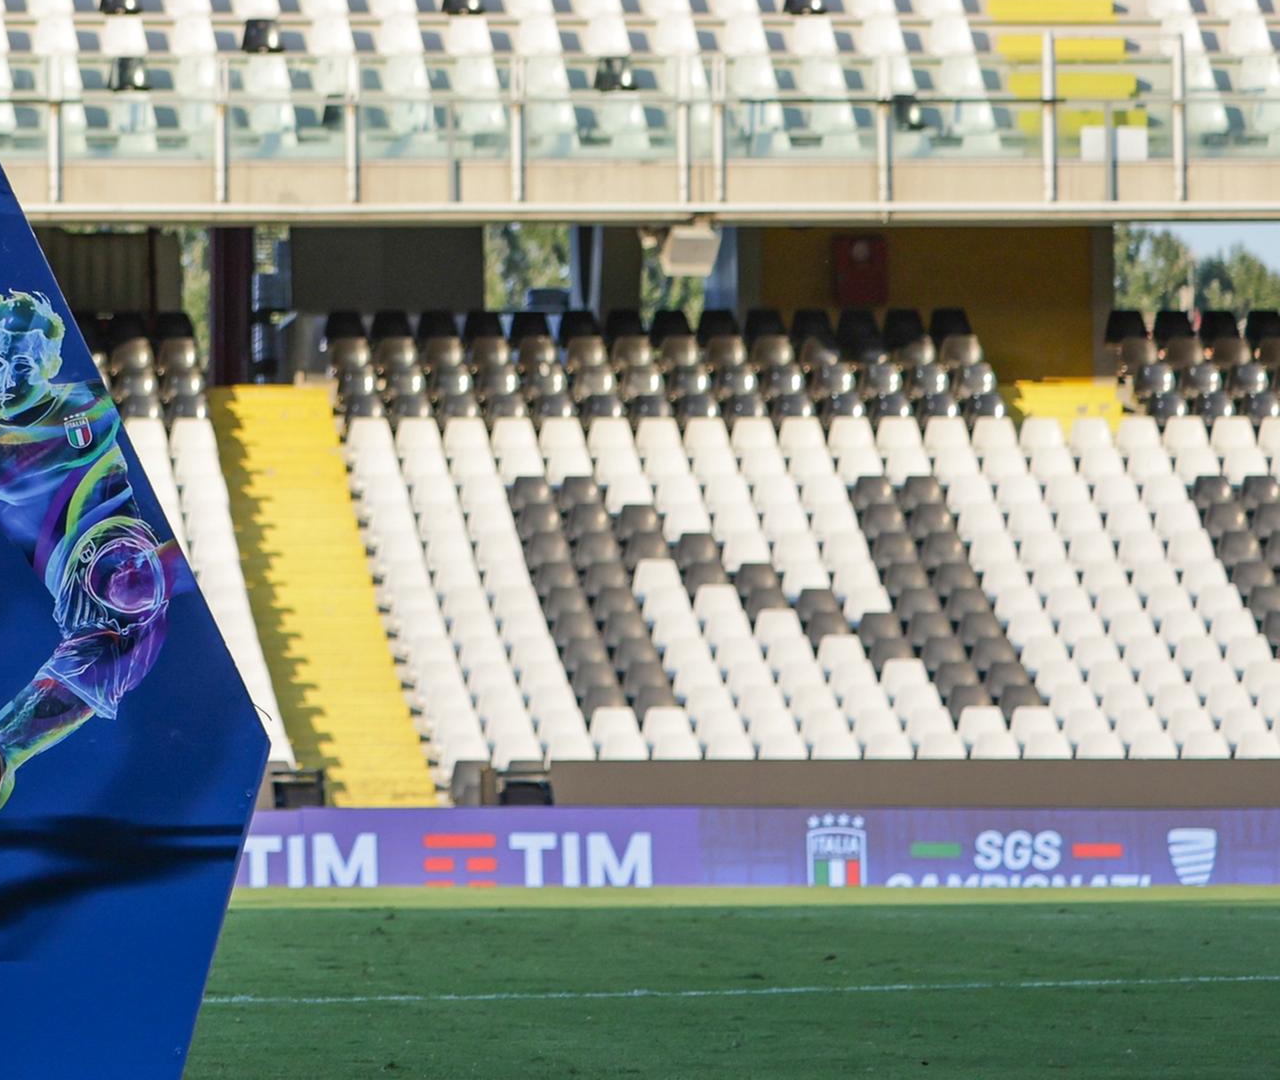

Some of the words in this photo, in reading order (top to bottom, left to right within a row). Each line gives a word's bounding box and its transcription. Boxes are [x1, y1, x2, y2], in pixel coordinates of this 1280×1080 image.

[242, 833, 378, 888] TIM
[508, 833, 653, 888] TIM
[814, 833, 860, 857] ITALIA
[973, 829, 1063, 872] SGS
